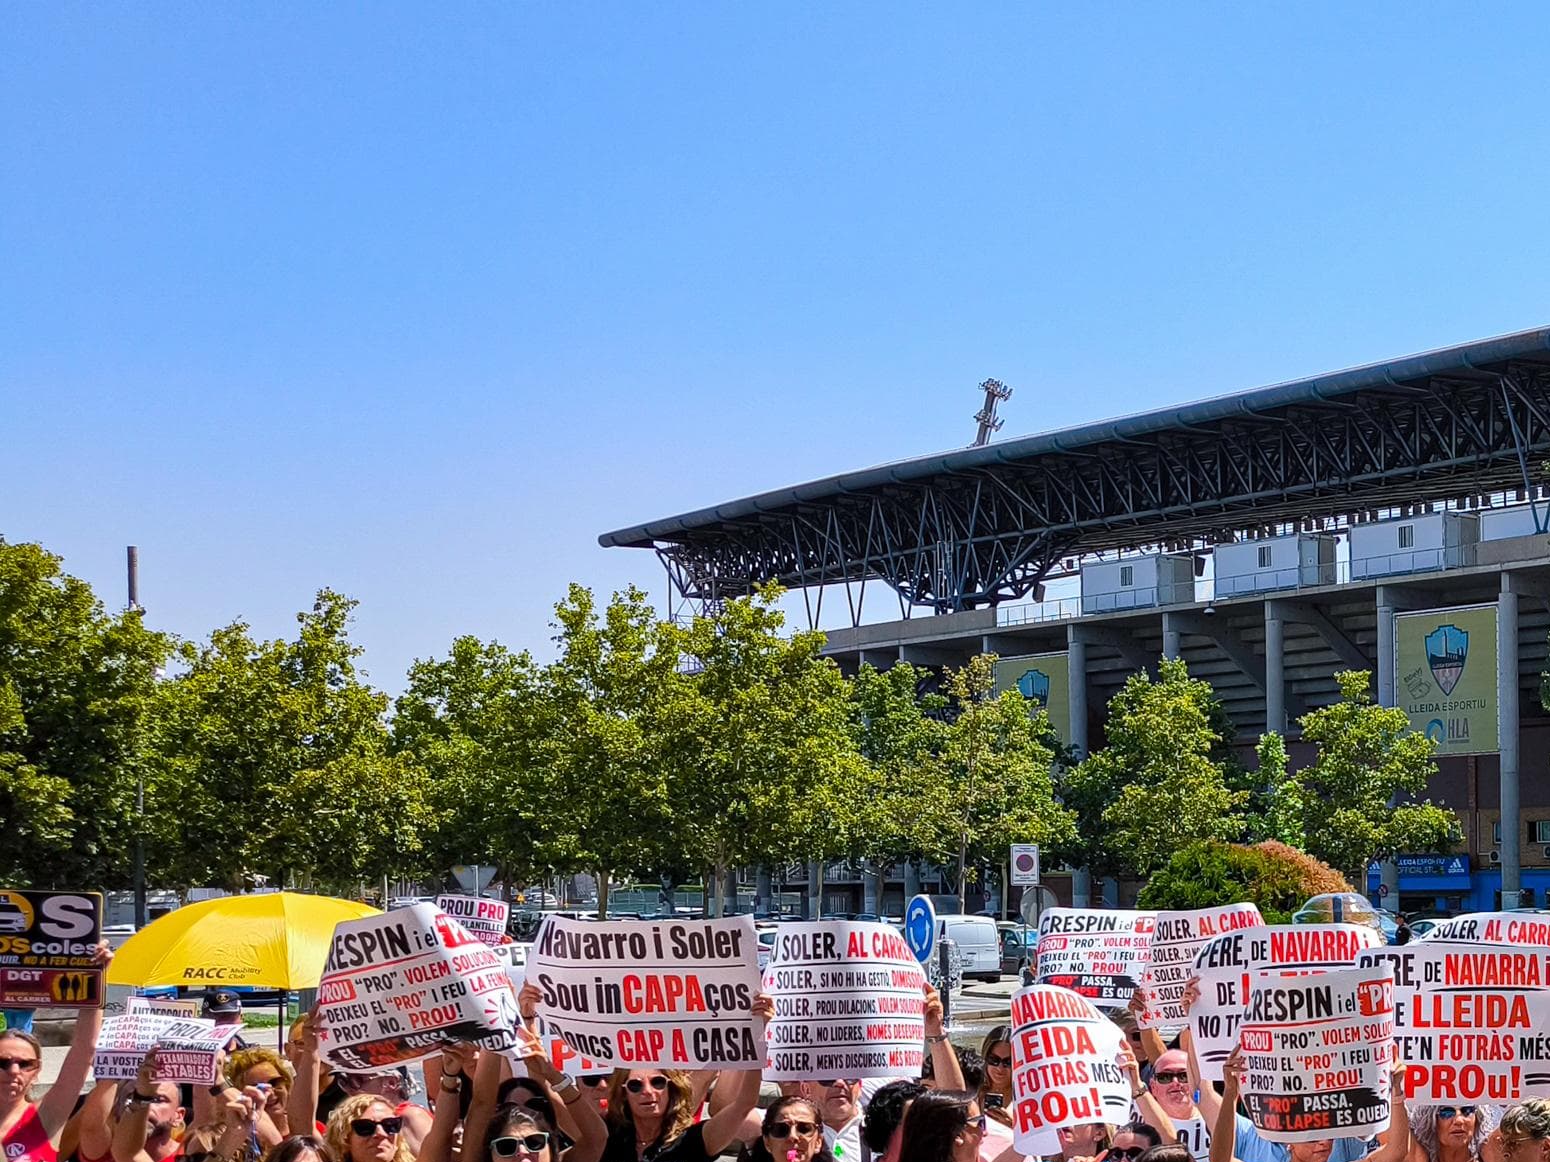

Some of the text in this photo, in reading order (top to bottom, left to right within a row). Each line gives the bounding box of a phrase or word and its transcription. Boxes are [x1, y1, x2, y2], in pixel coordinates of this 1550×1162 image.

[1408, 699, 1487, 714] LLEIDA ESPORTIU
[1447, 717, 1470, 739] HLA
[440, 899, 505, 921] PROU PRO
[1040, 915, 1116, 933] CRESPIN
[1156, 915, 1219, 940] SOLER, AL
[1432, 919, 1480, 942] SOLER,
[1484, 919, 1502, 942] AL
[538, 920, 742, 960] Navarro i Soler
[782, 931, 869, 961] SOLER, AL
[1251, 930, 1362, 963] DE NAVARRA
[7, 970, 43, 981] DGT
[183, 967, 228, 979] RACC
[776, 970, 817, 990] SOLER,
[1424, 953, 1541, 986] DE NAVARRA
[538, 973, 750, 1018] Sou inCAPAços
[1242, 984, 1332, 1022] CRESPIN
[775, 998, 814, 1018] SOLER,
[1412, 994, 1532, 1029] LLEIDA
[548, 1021, 759, 1063] Doncs CAP A CASA
[774, 1024, 813, 1045] SOLER,
[1322, 1026, 1361, 1046] VOLEM
[1438, 1029, 1515, 1062] FOTRÀS
[774, 1052, 814, 1073] SOLER,
[1350, 1049, 1370, 1065] FEU
[1314, 1068, 1364, 1090] PROU!
[1404, 1064, 1521, 1099] PROu!
[1303, 1093, 1353, 1111] PASSA.
